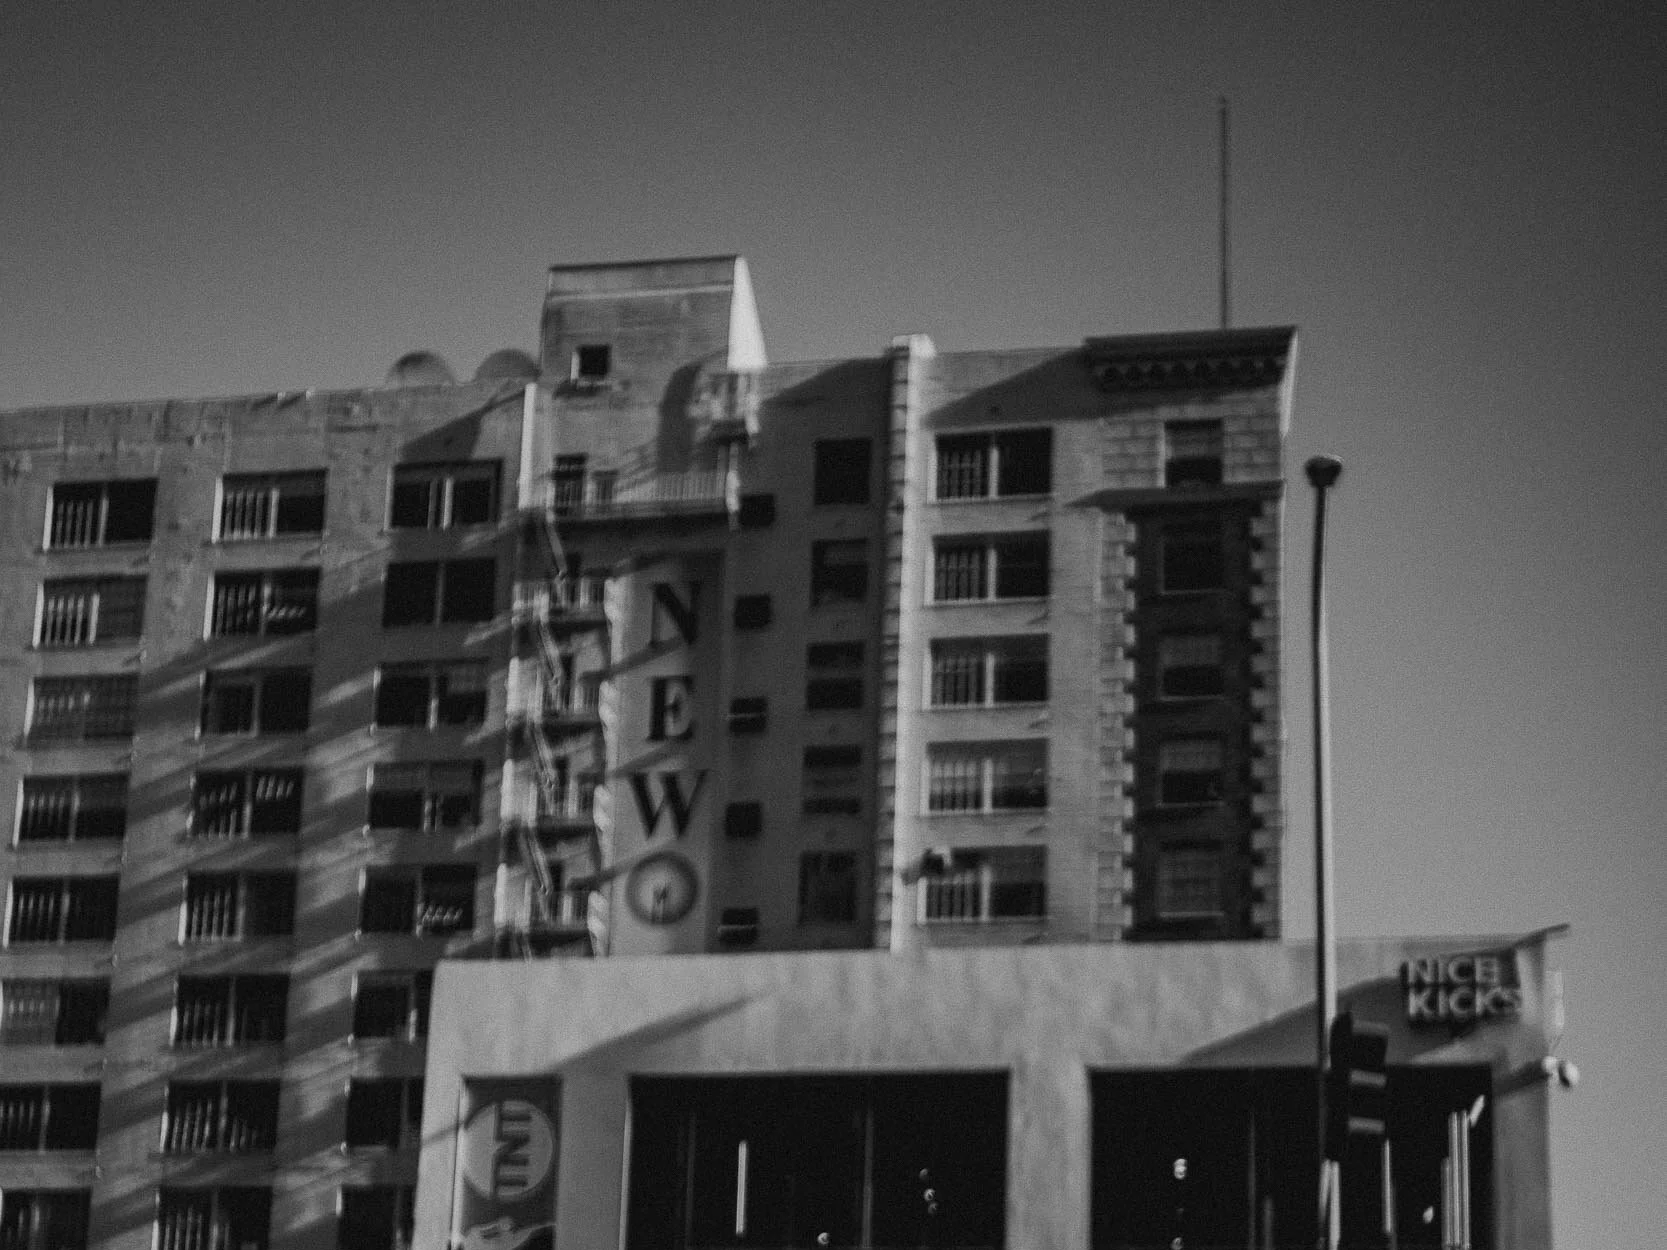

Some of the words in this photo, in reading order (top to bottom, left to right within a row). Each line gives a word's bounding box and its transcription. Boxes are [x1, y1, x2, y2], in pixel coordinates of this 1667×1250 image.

[1407, 957, 1500, 984] NICE
[1408, 984, 1522, 1018] KICKS
[493, 1103, 532, 1196] TNT
